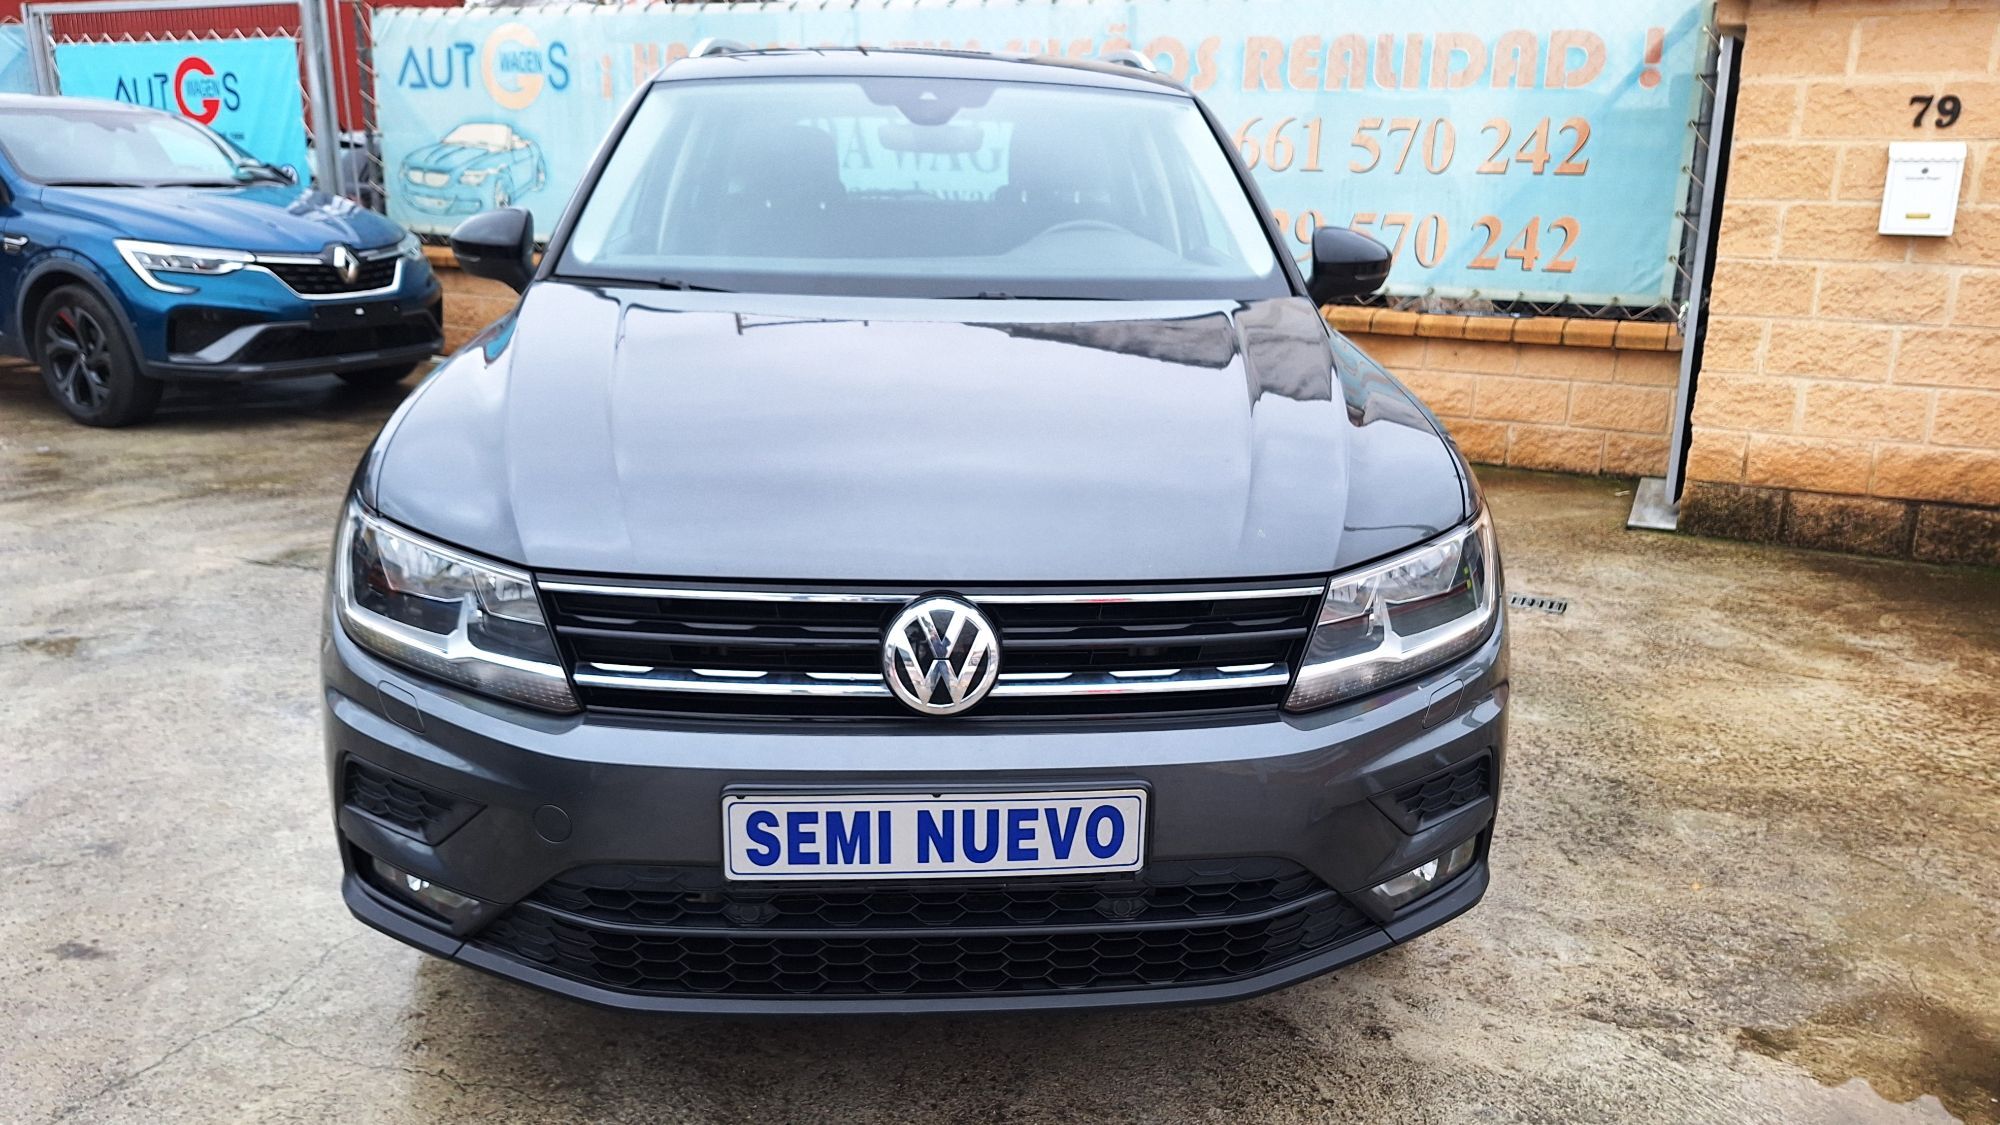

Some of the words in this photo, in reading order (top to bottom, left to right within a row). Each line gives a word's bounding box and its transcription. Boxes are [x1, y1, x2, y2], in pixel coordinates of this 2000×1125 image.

[1242, 30, 1606, 91] REALIDAD
[1909, 94, 1962, 128] 79
[1234, 117, 1323, 172] 661
[1350, 117, 1456, 175] 570
[1476, 116, 1592, 176] 242
[1466, 214, 1582, 273] 242
[745, 810, 893, 867] SEMI
[917, 804, 1126, 864] NUEVO
